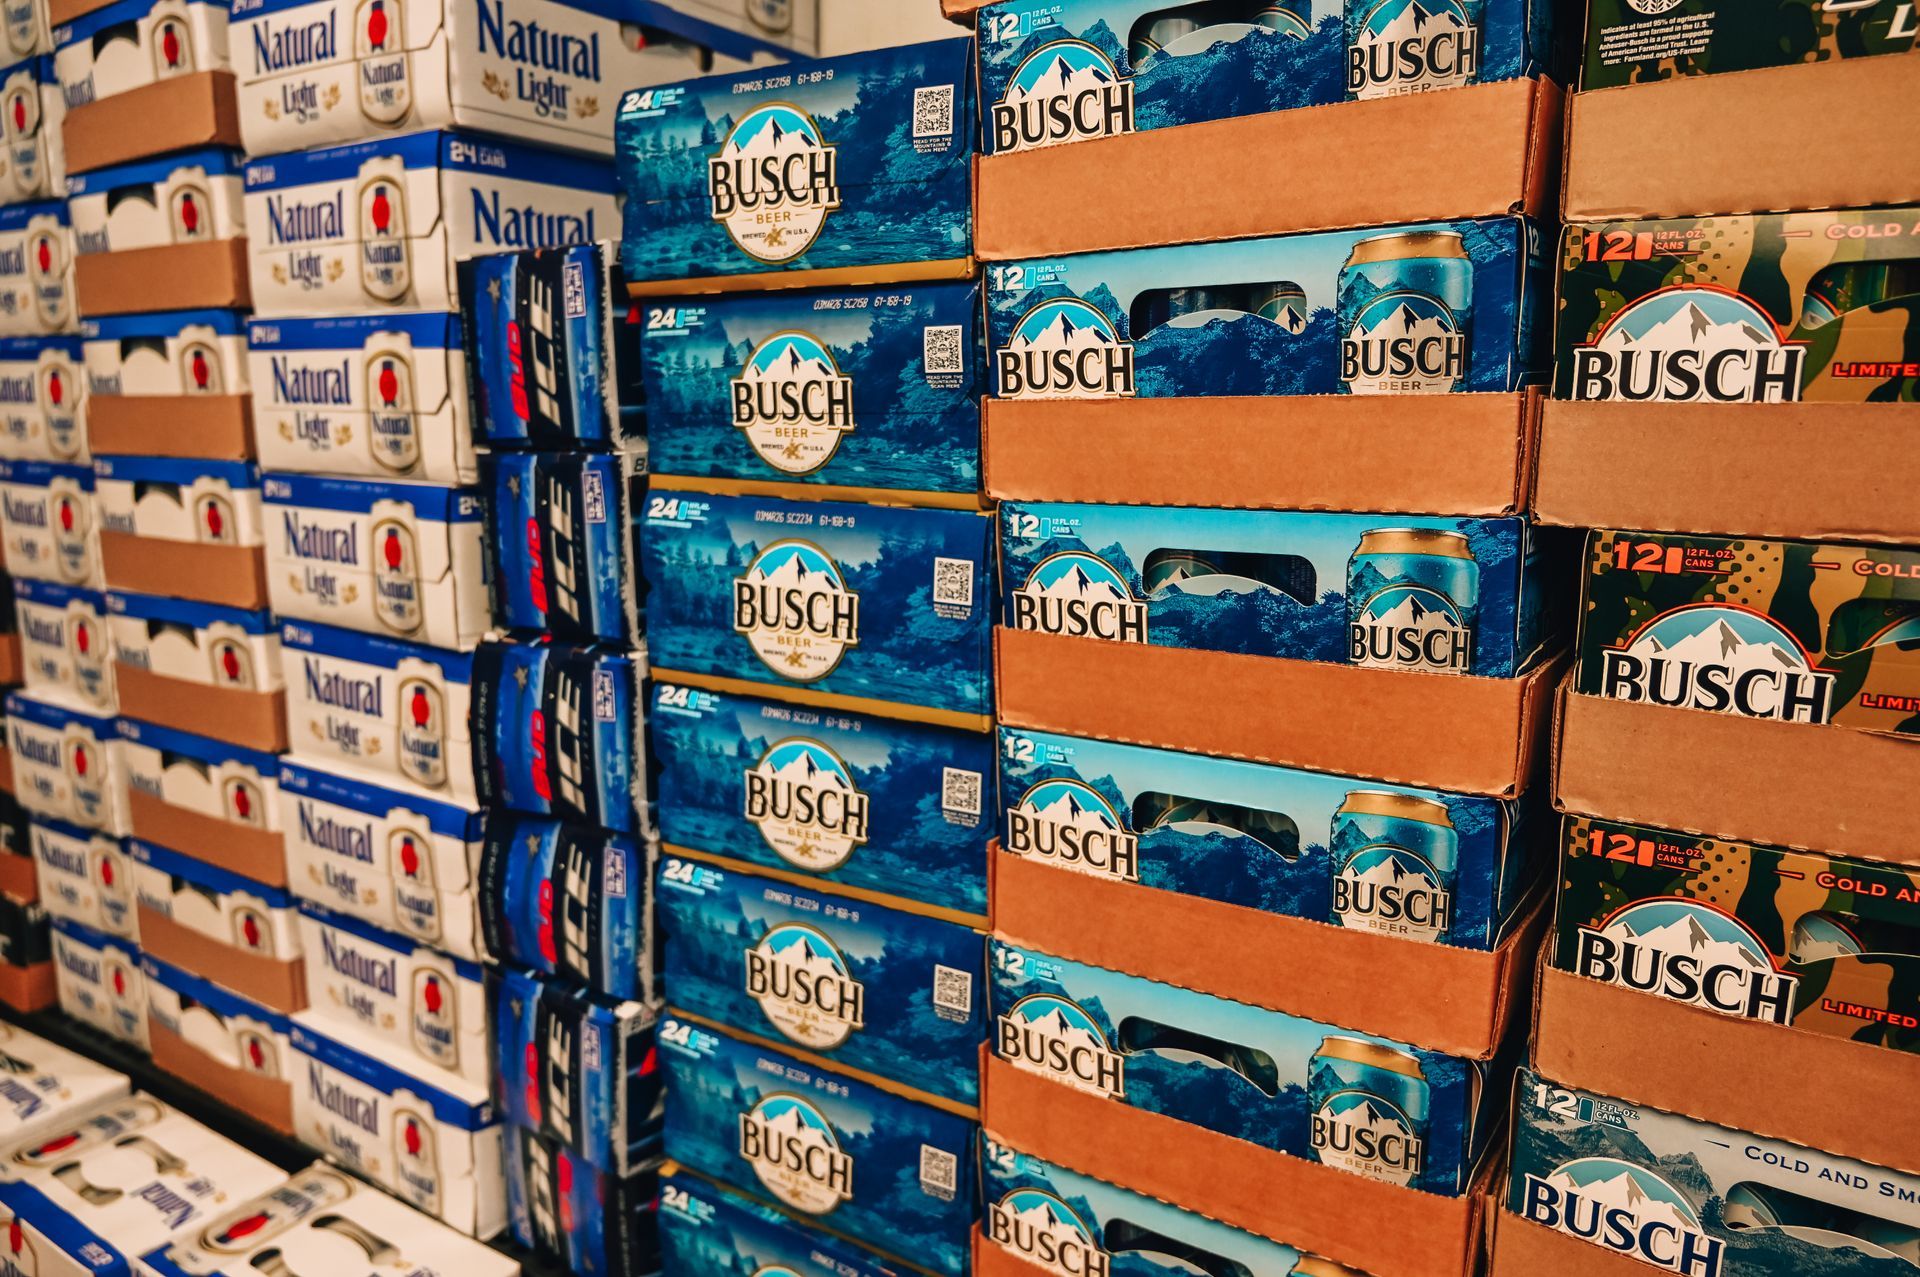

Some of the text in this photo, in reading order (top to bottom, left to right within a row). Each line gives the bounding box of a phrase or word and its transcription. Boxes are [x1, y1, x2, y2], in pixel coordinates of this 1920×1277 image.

[988, 13, 1020, 44] 12
[1599, 37, 1649, 51] Anheuser-Busch
[1661, 33, 1681, 43] proud
[1681, 28, 1714, 40] supporter
[1600, 11, 1716, 35] Indicates at least 95% of agricultural
[1650, 26, 1674, 36] farmed
[1682, 23, 1694, 31] the
[1694, 20, 1710, 29] U.S.
[253, 7, 337, 75] Natural
[477, 0, 601, 82] Natural
[1603, 46, 1705, 66] more: Farmland.org/US-Farmed
[1608, 47, 1638, 57] American
[1638, 42, 1669, 53] Farmland
[1670, 40, 1688, 49] Trust.
[1690, 38, 1710, 46] Learn
[362, 58, 405, 86] Natural
[1349, 29, 1476, 89] BUSCH
[282, 80, 319, 124] Light
[516, 67, 570, 117] Light
[622, 90, 653, 113] 24
[993, 84, 1132, 153] BUSCH
[449, 141, 477, 164] 24
[711, 151, 837, 215] BUSCH
[267, 188, 344, 245] Natural
[756, 211, 791, 224] BEER
[1824, 221, 1902, 241] COLD
[363, 240, 404, 265] Natural
[742, 232, 766, 240] BREWED
[1528, 224, 1540, 257] 12
[1583, 231, 1635, 262] 12
[1655, 241, 1685, 250] CANS
[289, 251, 323, 291] Light
[993, 265, 1024, 292] 12
[648, 309, 676, 329] 24
[813, 295, 912, 310] 03MAR26 SC2158 61-168-19
[530, 274, 562, 431] ICE
[1342, 335, 1463, 379] BUSCH
[271, 355, 352, 405] Natural
[507, 321, 530, 422] BUD
[999, 347, 1132, 394] BUSCH
[1378, 381, 1422, 391] BEER
[1577, 349, 1801, 402] BUSCH
[1832, 362, 1920, 378] LIMITE
[733, 379, 852, 427] BUSCH
[295, 411, 330, 450] Light
[775, 427, 809, 438] BEER
[648, 497, 679, 519] 24
[786, 513, 813, 525] SC2234
[283, 509, 359, 566] Natural
[1009, 513, 1040, 538] 12
[526, 517, 548, 615] BUD
[550, 476, 580, 625] ICE
[1613, 541, 1665, 574] 12
[1685, 558, 1715, 568] CANS
[1853, 559, 1920, 579] COLD
[736, 581, 856, 641] BUSCH
[1013, 592, 1145, 644] BUSCH
[777, 636, 812, 648] BEER
[1350, 623, 1470, 669] BUSCH
[304, 656, 383, 718] Natural
[658, 686, 688, 708] 24
[1604, 652, 1833, 725] BUSCH
[556, 670, 587, 815] ICE
[1004, 735, 1035, 763] 12
[747, 772, 866, 839] BUSCH
[298, 800, 374, 865] Natural
[787, 827, 822, 841] BEER
[1009, 811, 1135, 877] BUSCH
[1588, 829, 1639, 865] 12
[663, 859, 693, 885] 24
[1656, 853, 1685, 865] CANS
[1815, 872, 1889, 897] COLD
[563, 843, 592, 981] ICE
[1333, 876, 1450, 930] BUSCH
[1368, 919, 1409, 934] BEER
[321, 925, 397, 998] Natural
[995, 947, 1025, 976] 12
[1579, 929, 1794, 1027] BUSCH
[749, 952, 860, 1024] BUSCH
[1822, 998, 1918, 1029] LIMITED
[661, 1020, 691, 1049] 24
[1001, 1019, 1125, 1094] BUSCH
[308, 1058, 379, 1137] Natural
[1533, 1082, 1577, 1120] 12
[1596, 1111, 1622, 1125] CANS
[743, 1115, 849, 1193] BUSCH
[986, 1140, 1016, 1169] 12
[1311, 1115, 1422, 1173] BUSCH
[1344, 1157, 1383, 1174] BEER
[1743, 1144, 1920, 1205] COLD AND SM
[662, 1185, 689, 1210] 24
[991, 1206, 1106, 1277] BUSCH
[1524, 1174, 1725, 1277] BUSCH
